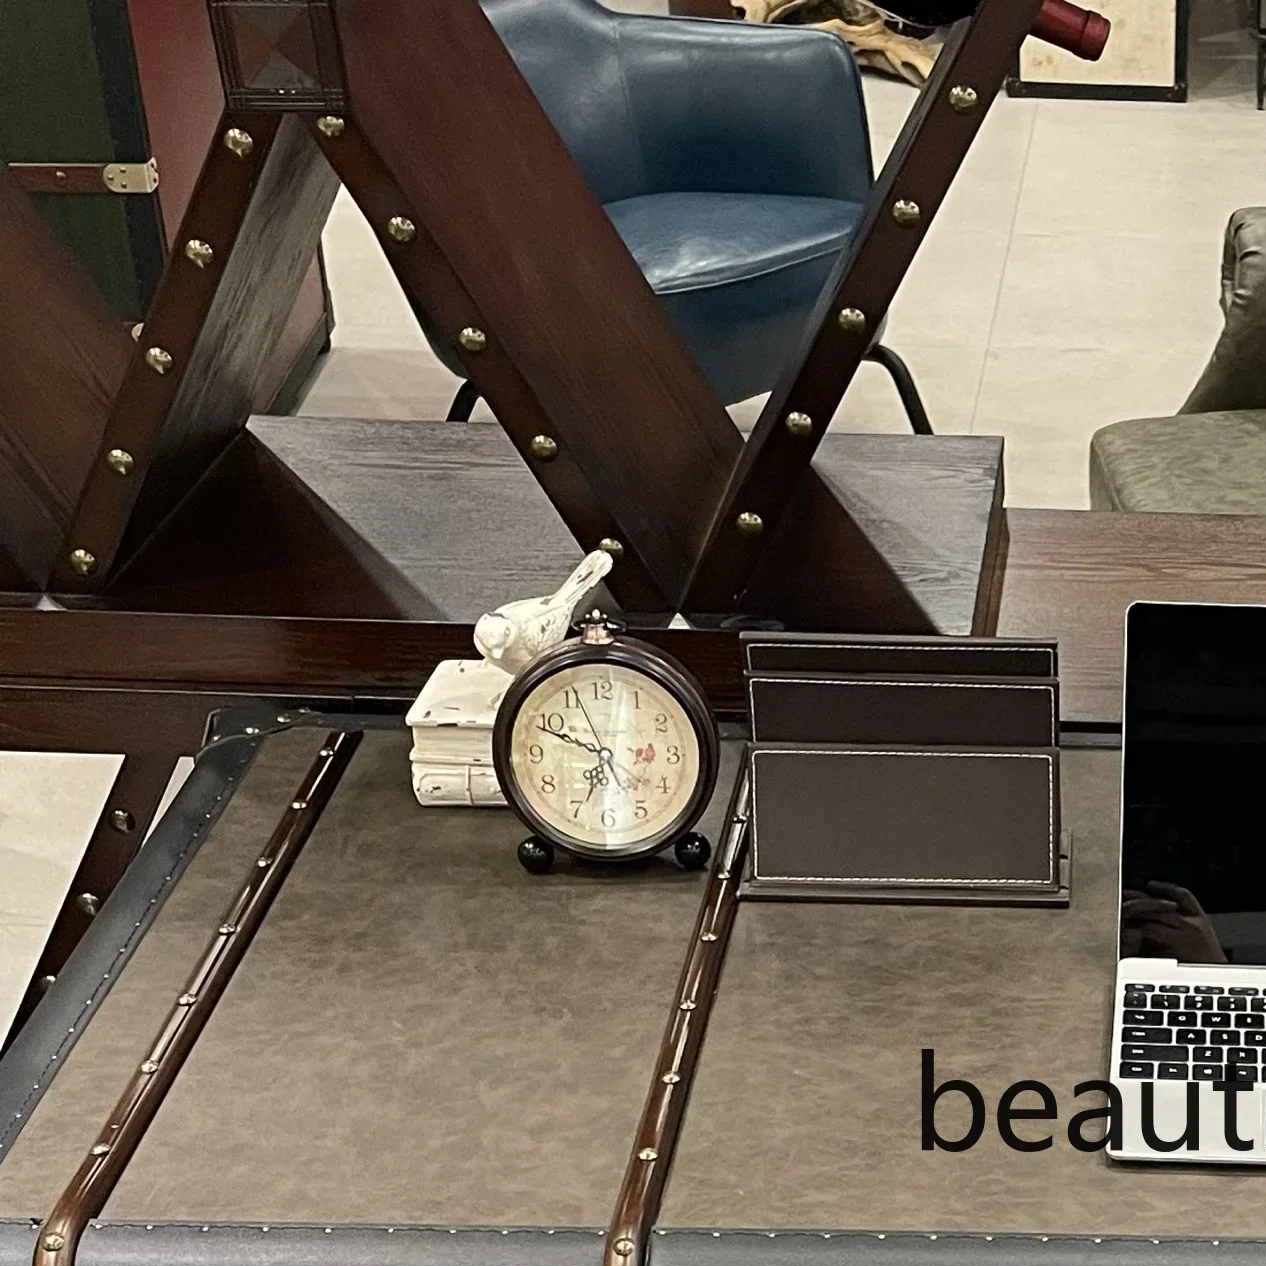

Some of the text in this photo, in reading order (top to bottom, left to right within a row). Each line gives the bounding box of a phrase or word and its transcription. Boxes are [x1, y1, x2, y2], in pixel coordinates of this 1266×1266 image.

[563, 690, 581, 709] 11
[591, 680, 614, 701] 12
[633, 690, 641, 710] 1
[538, 713, 565, 732] 10
[655, 713, 668, 733] 2
[529, 744, 544, 764] 9
[666, 745, 680, 765] 3
[541, 774, 556, 794] 8
[655, 775, 671, 794] 4
[569, 800, 584, 819] 7
[601, 808, 616, 828] 6
[634, 800, 648, 819] 5
